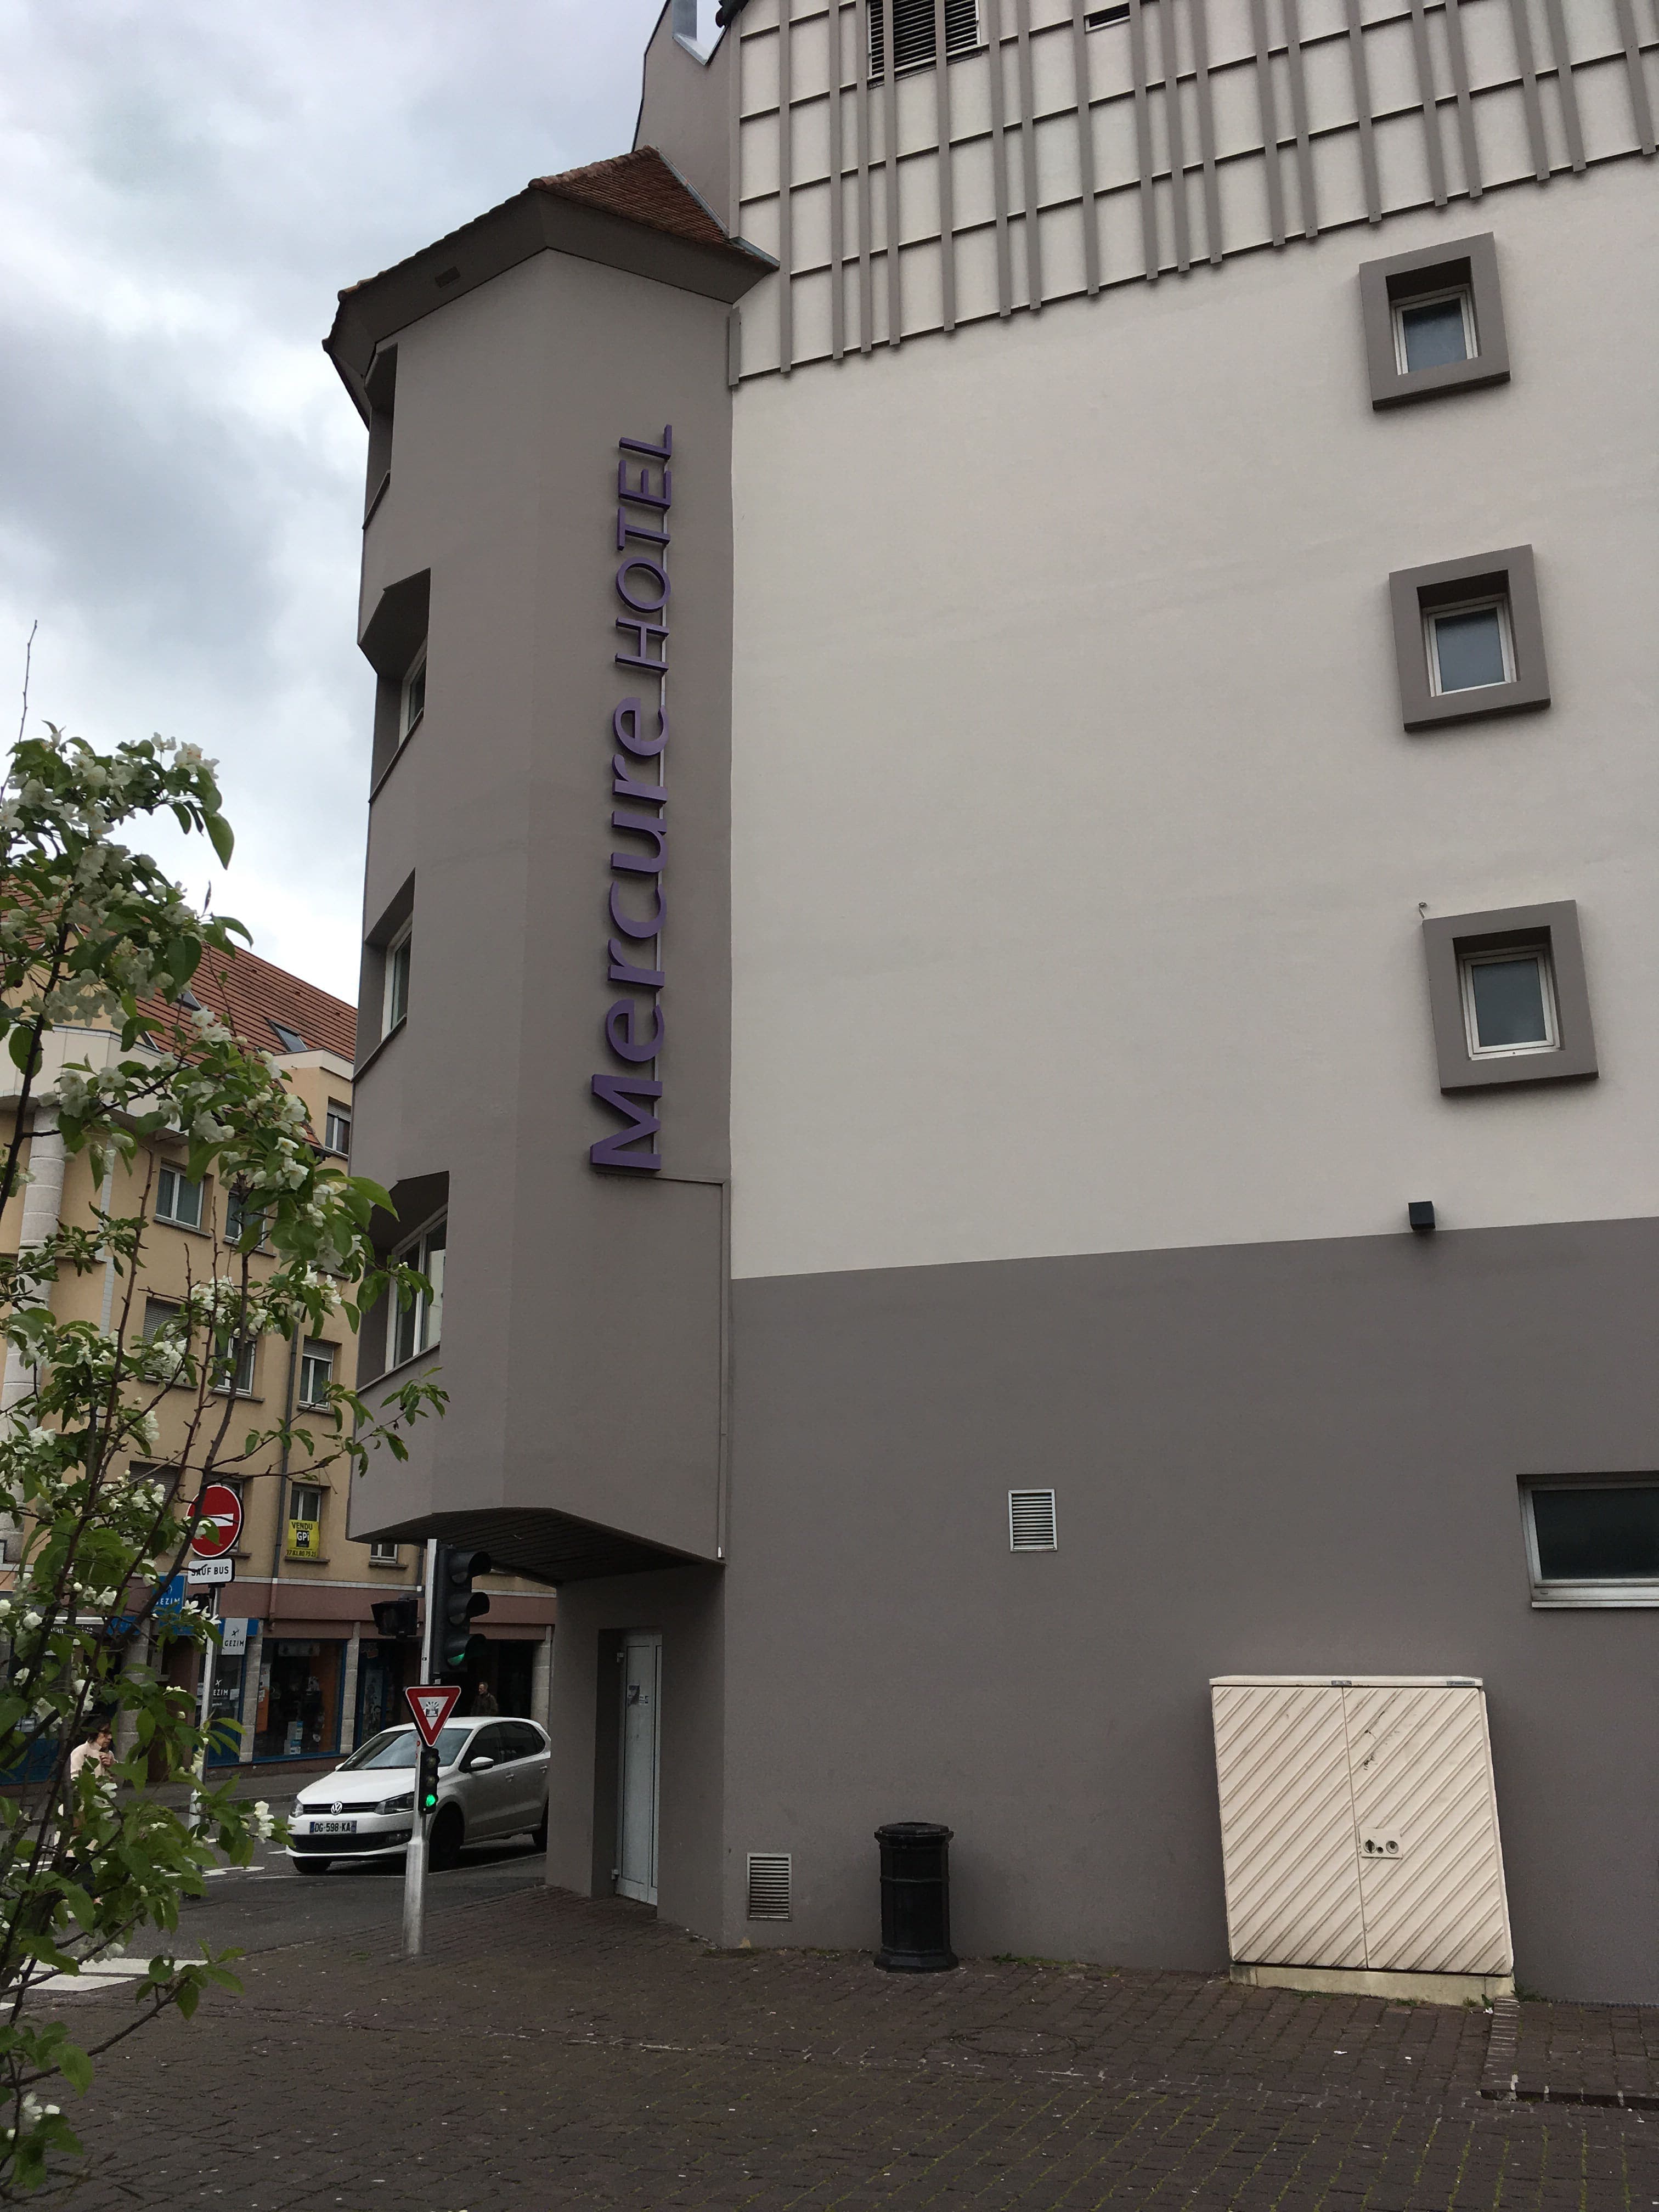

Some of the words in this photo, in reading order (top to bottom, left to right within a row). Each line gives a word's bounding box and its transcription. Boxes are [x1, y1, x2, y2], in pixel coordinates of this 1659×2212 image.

[615, 424, 673, 672] HOTEL
[590, 697, 669, 1172] Mercure
[214, 1566, 229, 1575] BUS
[291, 1522, 313, 1530] VENDU
